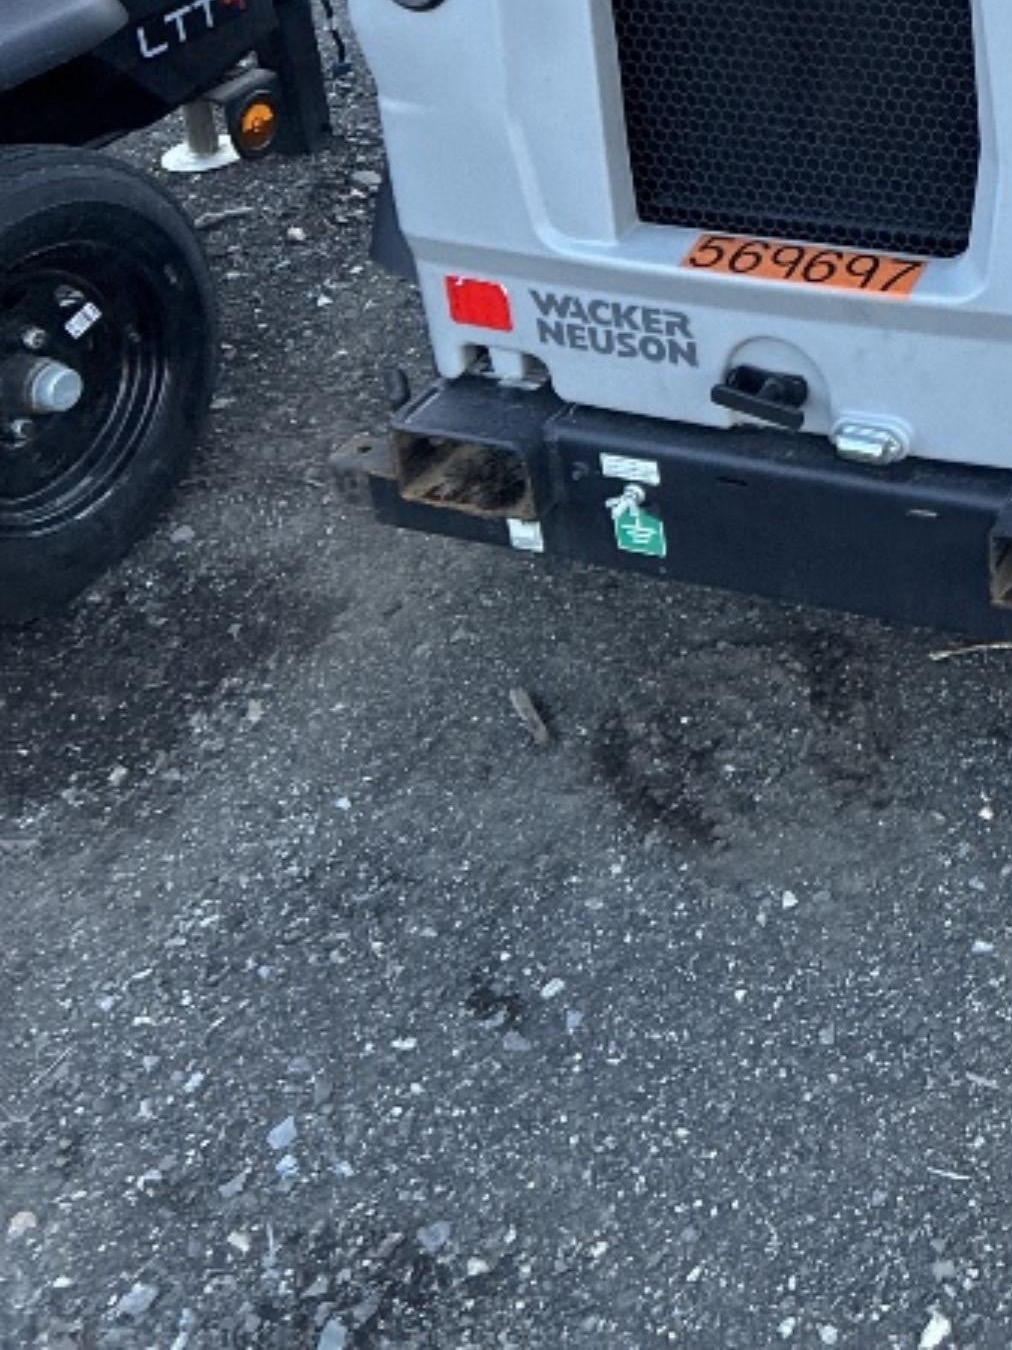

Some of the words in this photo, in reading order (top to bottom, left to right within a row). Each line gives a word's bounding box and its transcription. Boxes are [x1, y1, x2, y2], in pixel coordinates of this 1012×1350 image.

[688, 236, 923, 292] 569697
[529, 287, 694, 340] WACKER
[536, 317, 698, 368] NEUSON
